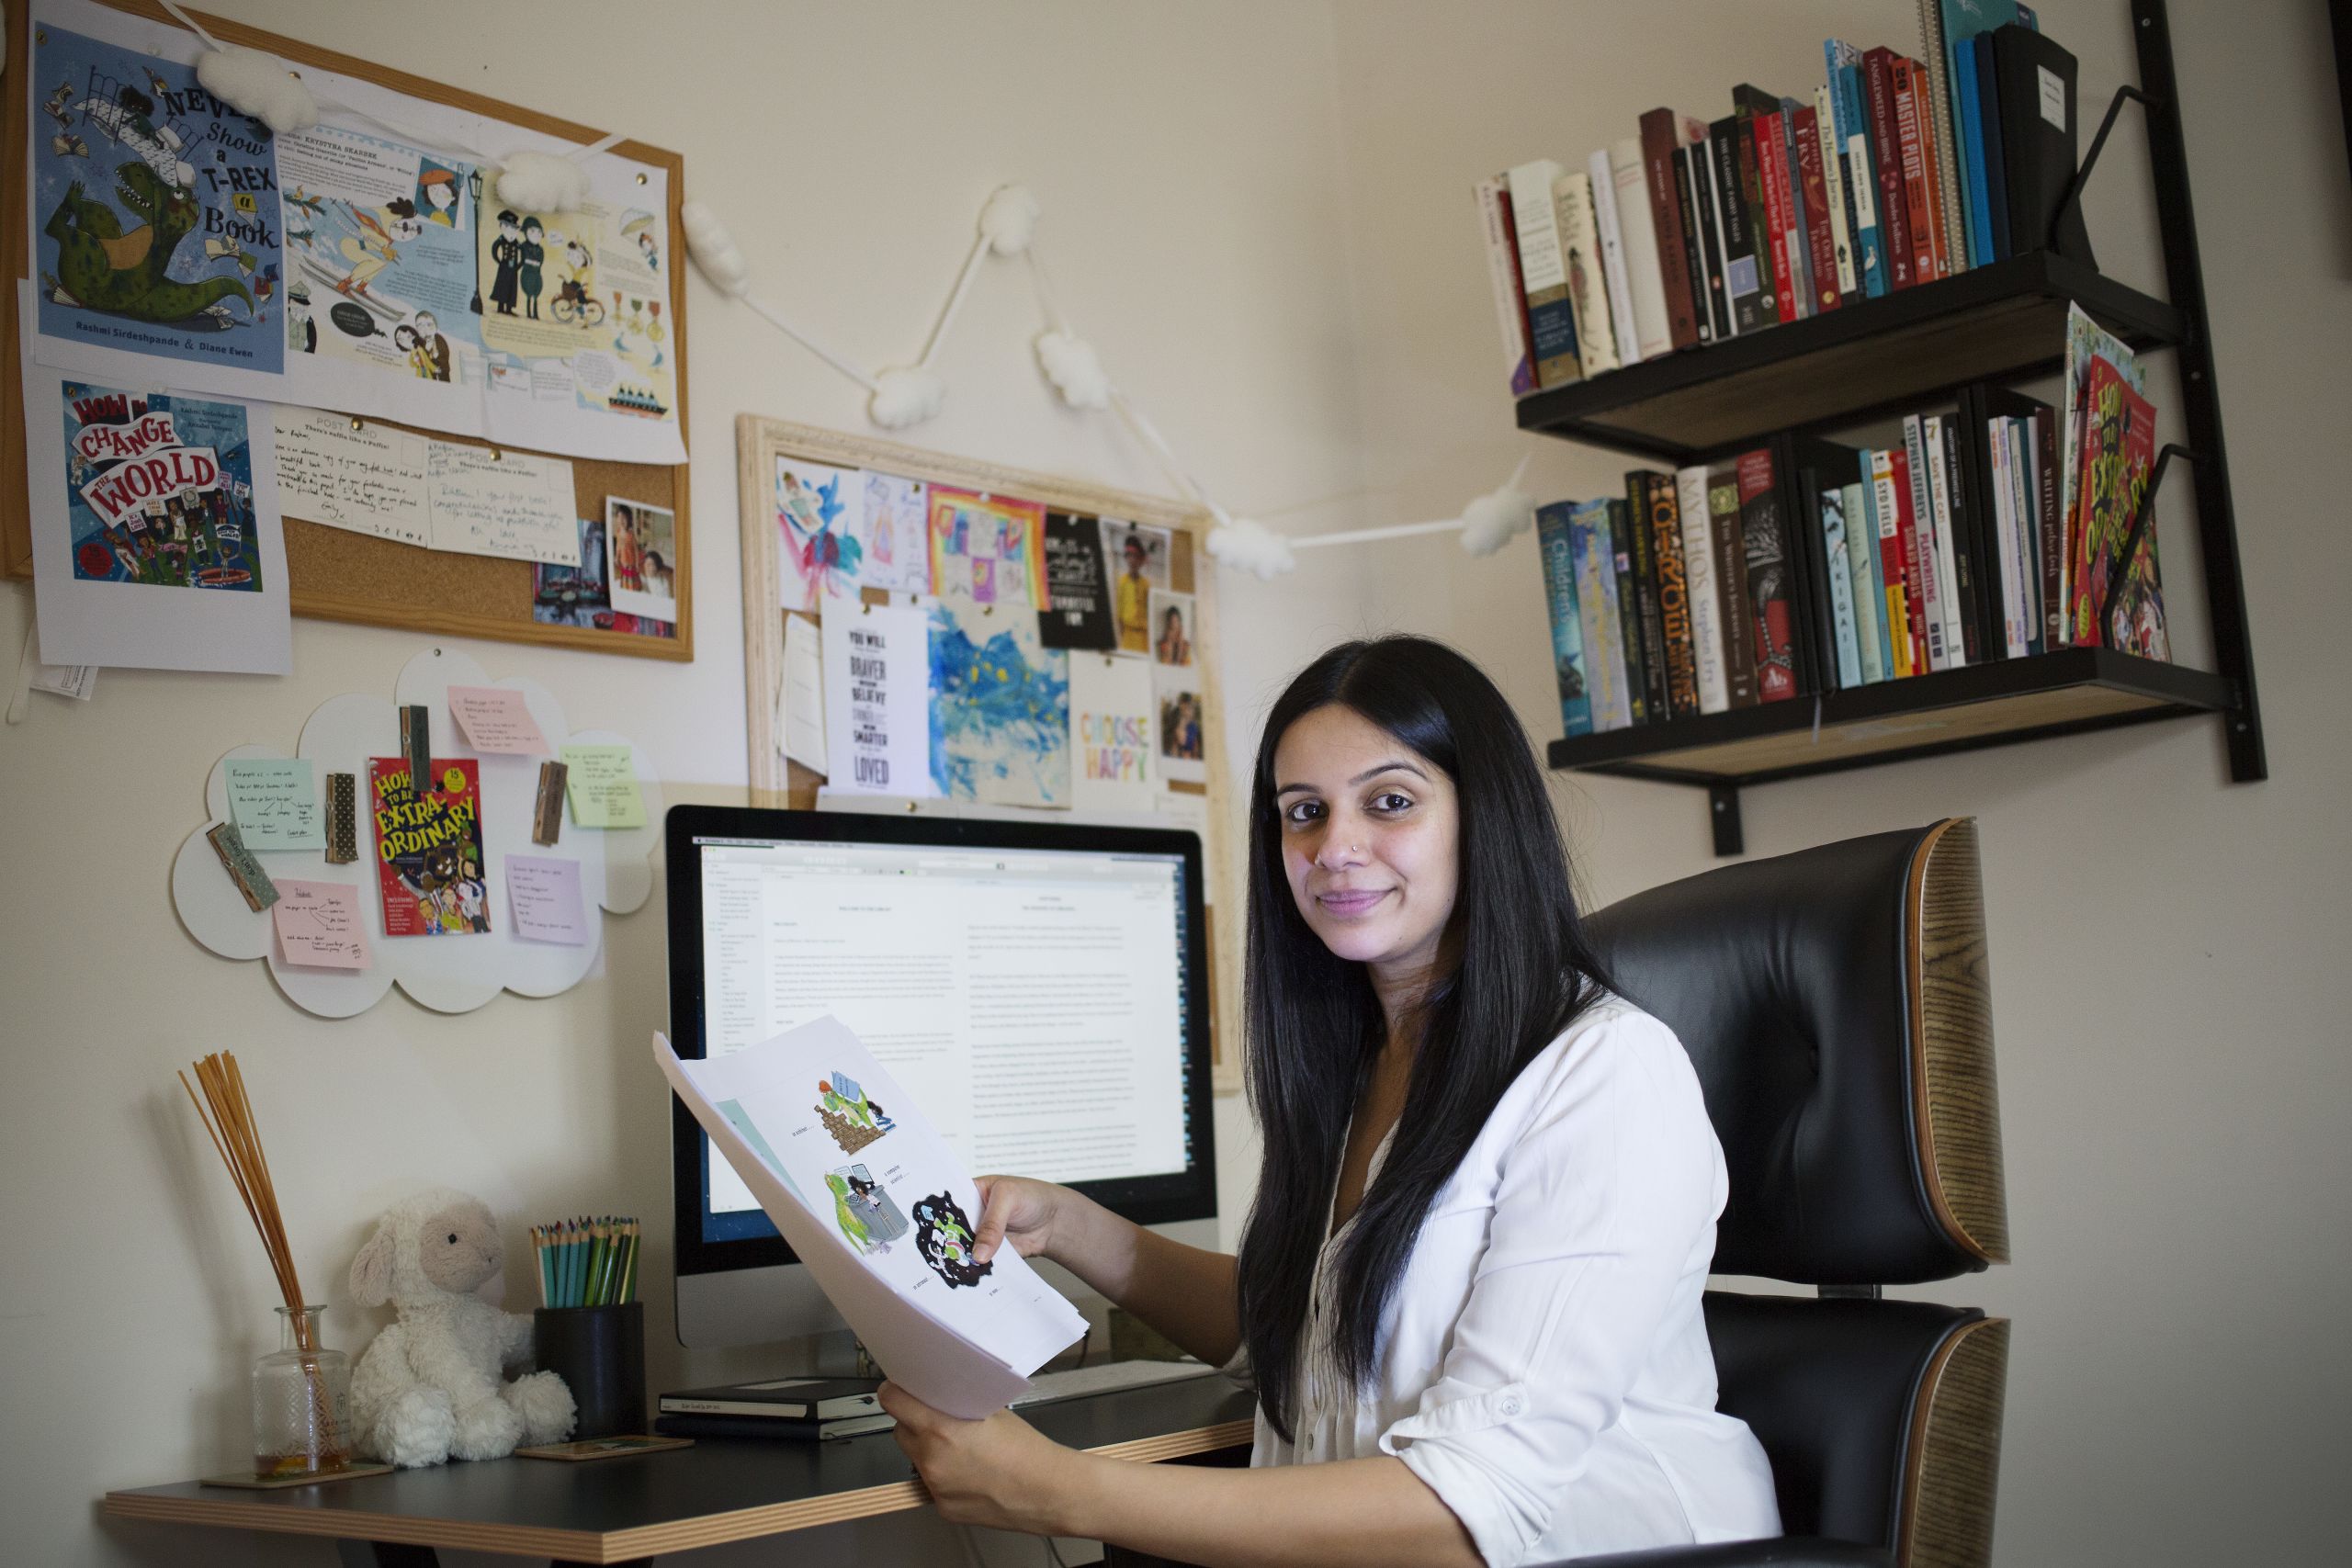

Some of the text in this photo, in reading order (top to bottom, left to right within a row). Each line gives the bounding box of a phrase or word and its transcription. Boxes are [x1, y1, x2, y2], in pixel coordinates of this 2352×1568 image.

[166, 87, 259, 123] NEV
[1868, 58, 1884, 118] TANGLEWEED
[1878, 137, 1893, 164] BRINE
[1894, 66, 1922, 179] 20 MASTER PLOTS
[207, 122, 267, 155] Show
[217, 149, 226, 163] a
[1795, 128, 1815, 172] FRY
[1808, 118, 1822, 174] STEPHEN
[202, 167, 277, 192] T-REX
[240, 196, 251, 209] a
[204, 206, 279, 250] Book
[1818, 220, 1830, 237] THE
[75, 321, 253, 358] Rashmi Sirdeshpande & Diane Ewen
[72, 394, 130, 423] HOW
[317, 418, 344, 430] POST
[81, 417, 175, 457] CHANGE
[1906, 424, 1920, 469] STEPHEN
[91, 453, 216, 518] WORLD
[95, 475, 110, 490] THE
[1912, 473, 1927, 521] JEFFREYS
[1930, 456, 1945, 525] SAVE THE CAT!
[2043, 468, 2054, 521] WRITING
[1876, 481, 1894, 536] SYD FIELD
[1553, 539, 1570, 624] Children's
[1654, 502, 1686, 639] CIRCE
[1682, 479, 1716, 684] MYTHOS Stephen Fry
[1919, 533, 1937, 604] PLAYWRITING
[1834, 557, 1848, 643] IKIGAI
[851, 656, 886, 681] BRAVER
[854, 729, 888, 747] SMARTER
[1080, 713, 1149, 749] CHOOSE
[451, 770, 458, 779] 15
[854, 755, 889, 784] LOVED
[1086, 748, 1147, 781] HAPPY
[375, 794, 447, 835] EXTRA-
[387, 794, 399, 805] TO
[380, 796, 475, 862] ORDINARY
